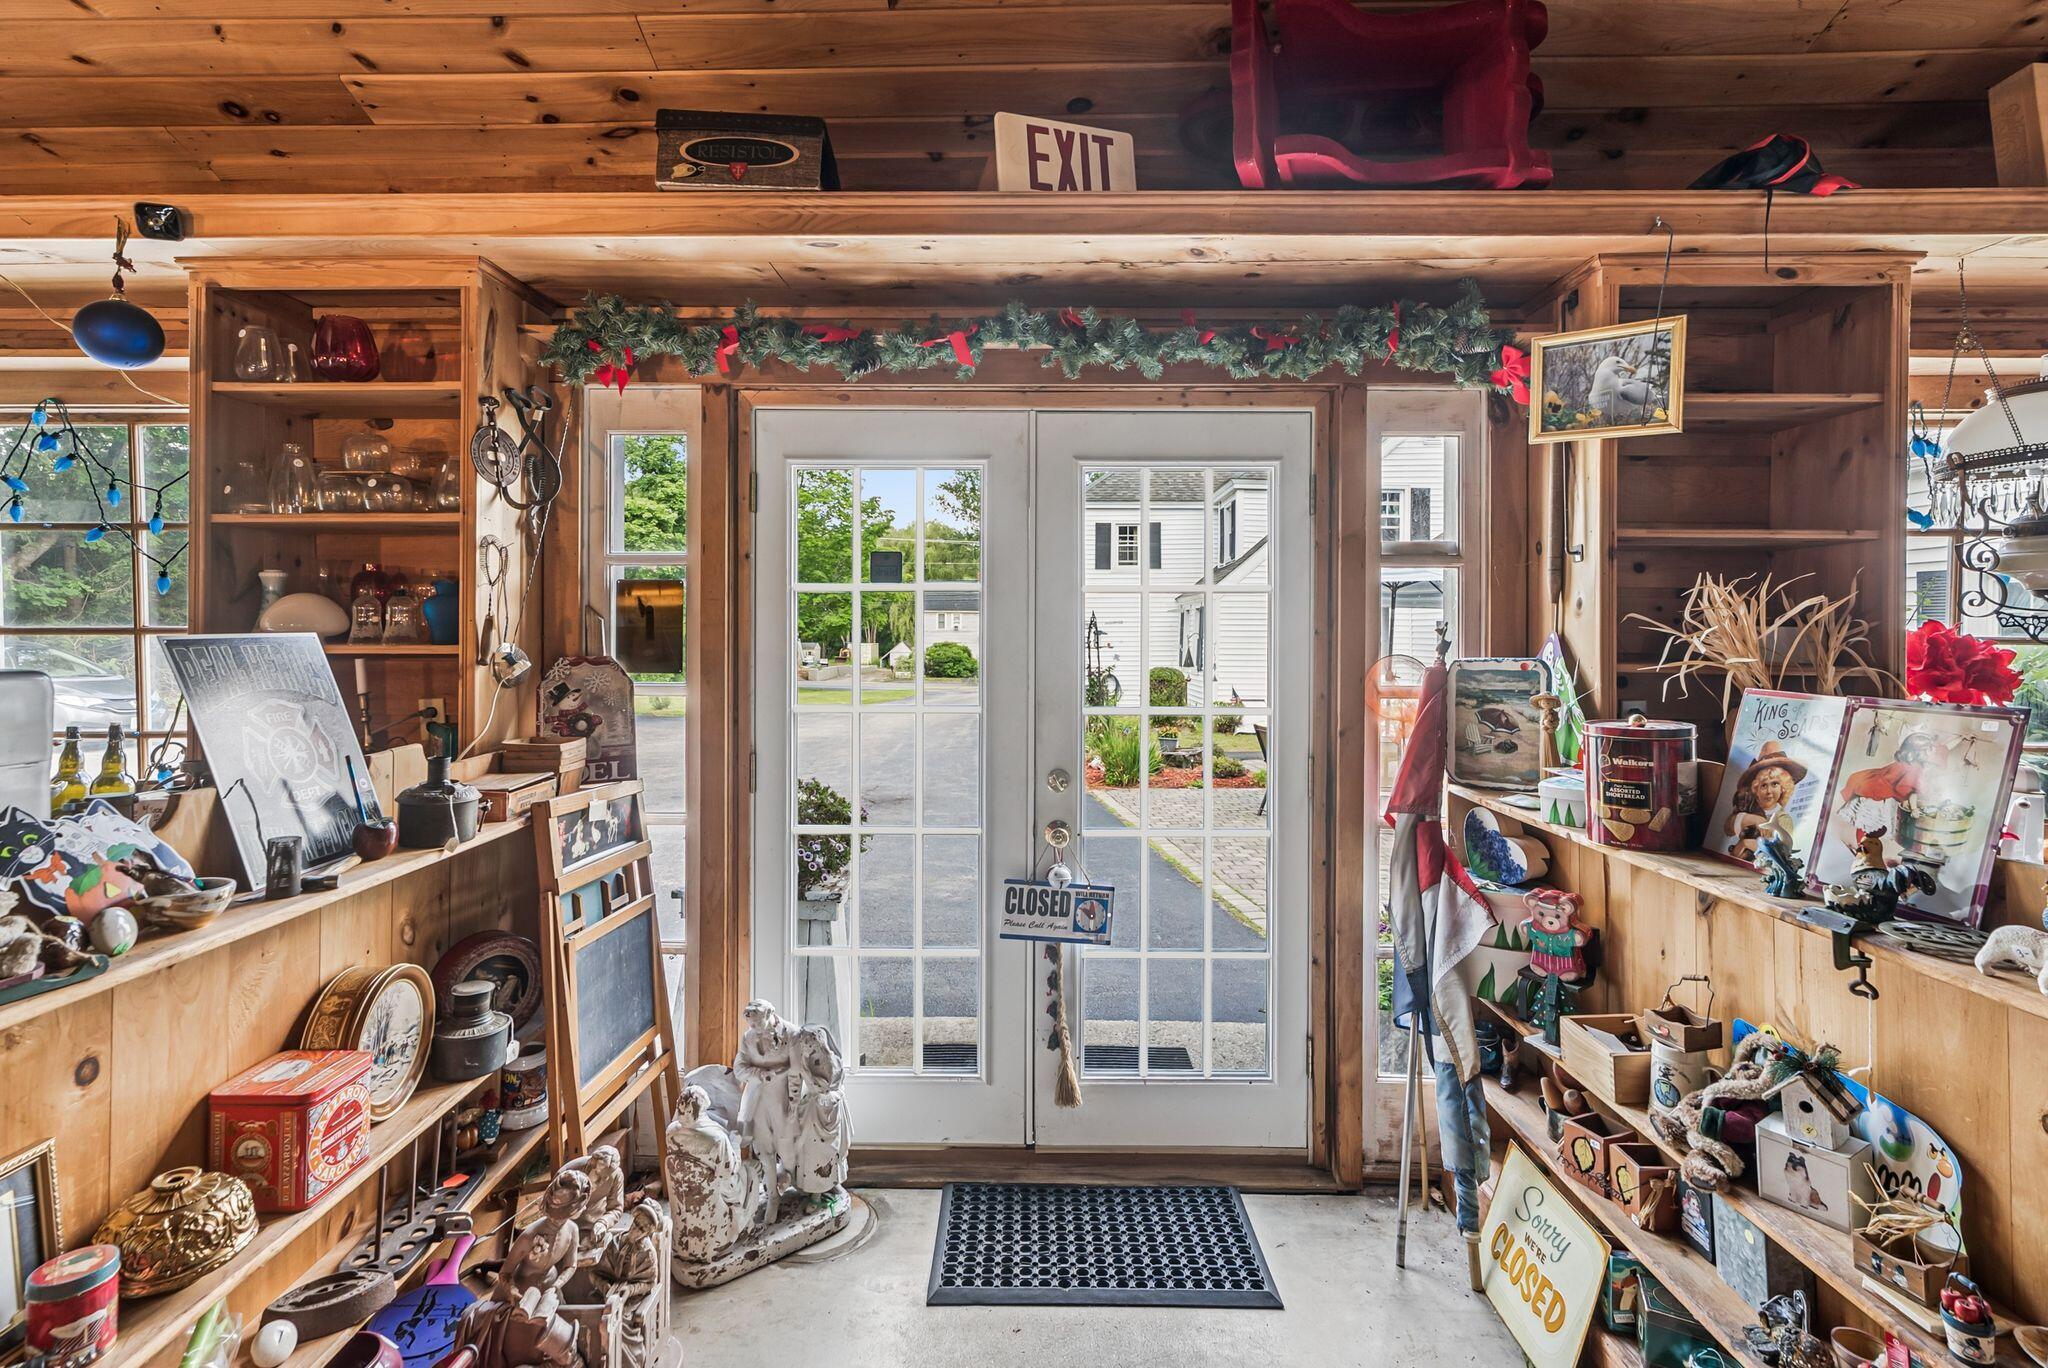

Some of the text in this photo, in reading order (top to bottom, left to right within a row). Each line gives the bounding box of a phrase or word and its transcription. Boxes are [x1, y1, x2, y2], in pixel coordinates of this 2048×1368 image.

[697, 144, 782, 160] RESISTOL
[1026, 124, 1114, 191] EXIT
[266, 711, 291, 723] FIRE
[1755, 698, 1788, 730] KING
[1612, 757, 1655, 767] Walkers
[1605, 791, 1646, 800] SHORTBREAD
[1004, 886, 1072, 918] CLOSED
[1075, 890, 1109, 899] WILL RETURN
[1002, 918, 1068, 931] Please Call Again
[1515, 1186, 1572, 1263] Sorry
[1524, 1232, 1547, 1265] WE'RE
[1491, 1222, 1567, 1334] CLOSED
